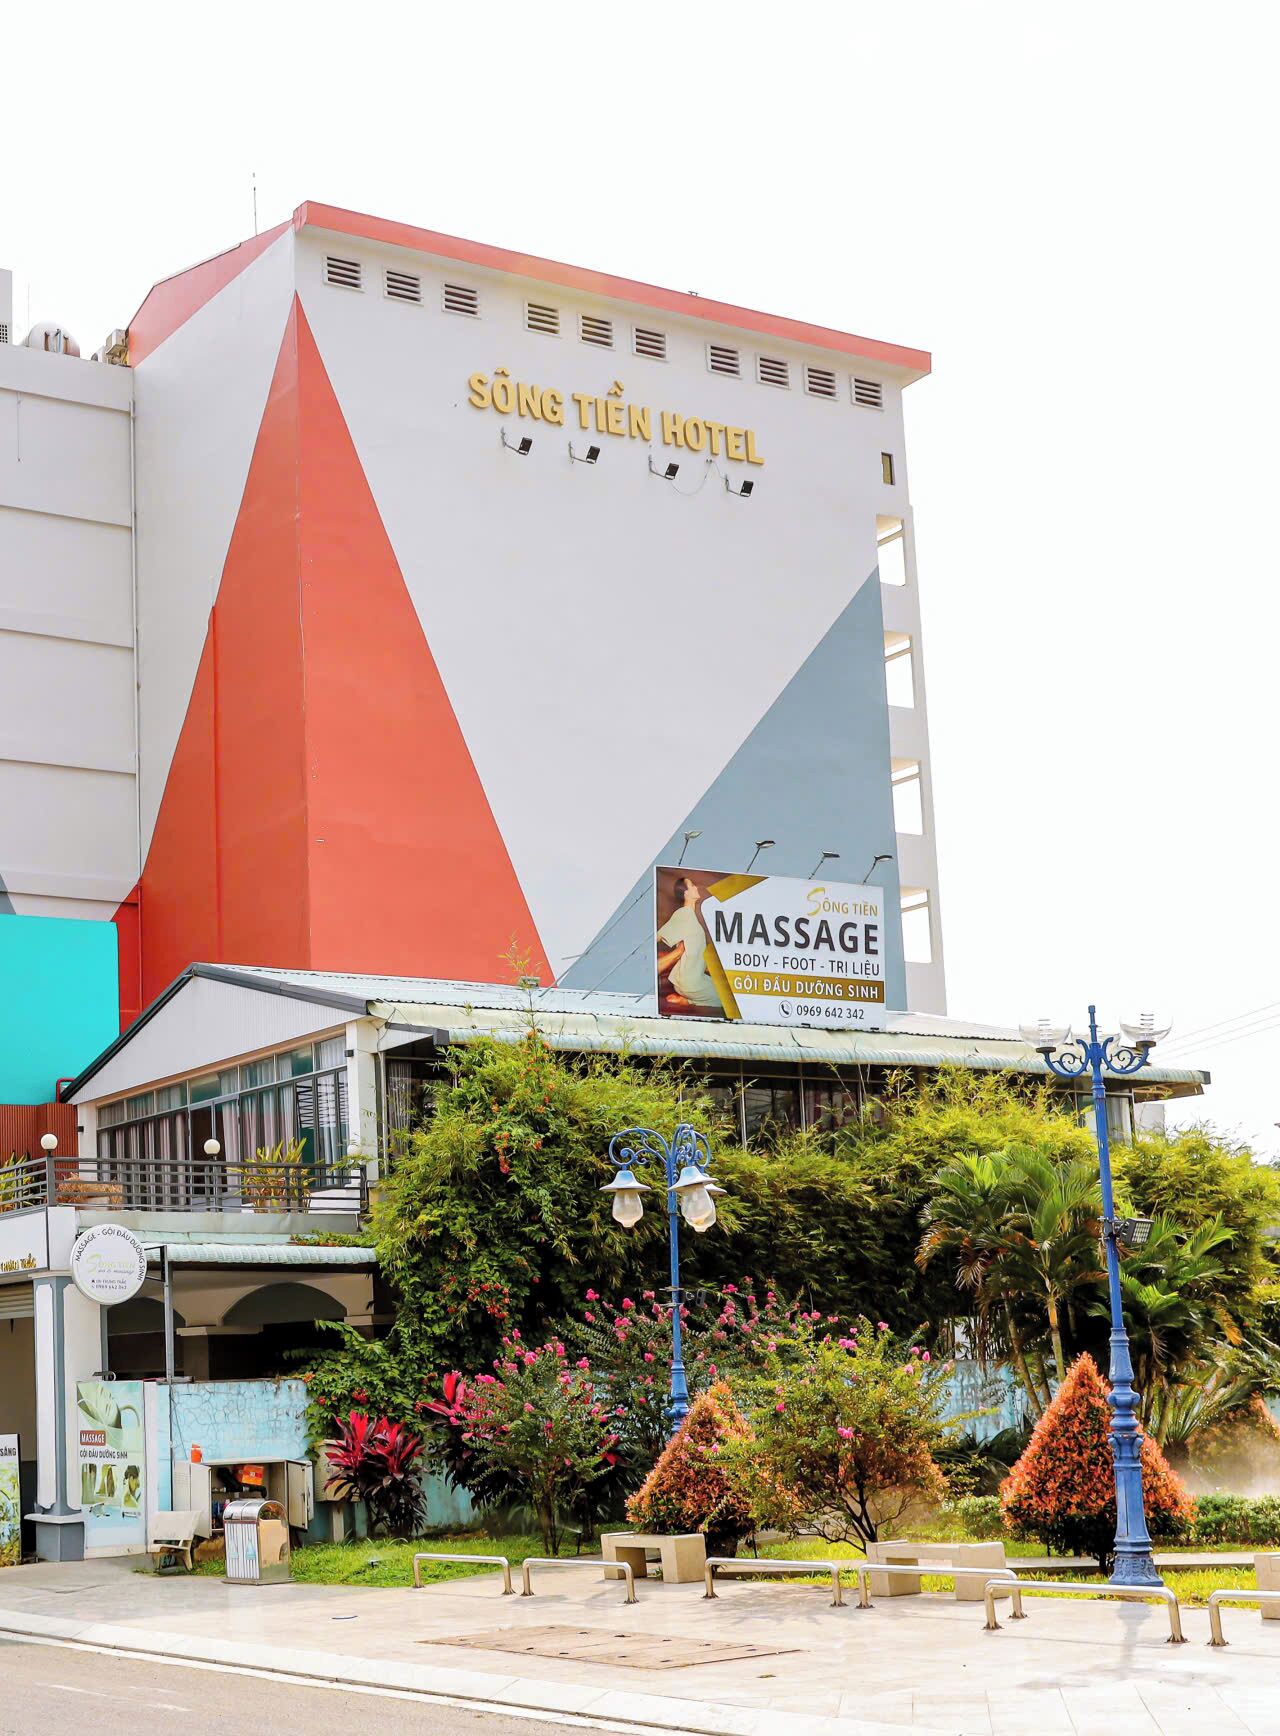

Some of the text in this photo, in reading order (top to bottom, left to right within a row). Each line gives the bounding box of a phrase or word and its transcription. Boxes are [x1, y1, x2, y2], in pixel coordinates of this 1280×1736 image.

[468, 367, 765, 465] SÔNG TIỀN HOTEL
[806, 887, 878, 916] SÔNG TIỀN
[715, 910, 878, 955] MASSAGE
[734, 953, 769, 968] BODY
[782, 957, 816, 971] FOOT
[829, 960, 848, 976] TRỊ
[852, 960, 880, 979] LIỆU
[734, 975, 878, 999] GỘI ĐẦU DƯỠNG SINH
[797, 1005, 864, 1020] 0969 642 342
[75, 1233, 97, 1262] MASSAGE
[136, 1265, 145, 1282] SINH
[81, 1433, 105, 1443] MASSAGE
[0, 1446, 17, 1457] SÁNG
[116, 1451, 128, 1459] SINH
